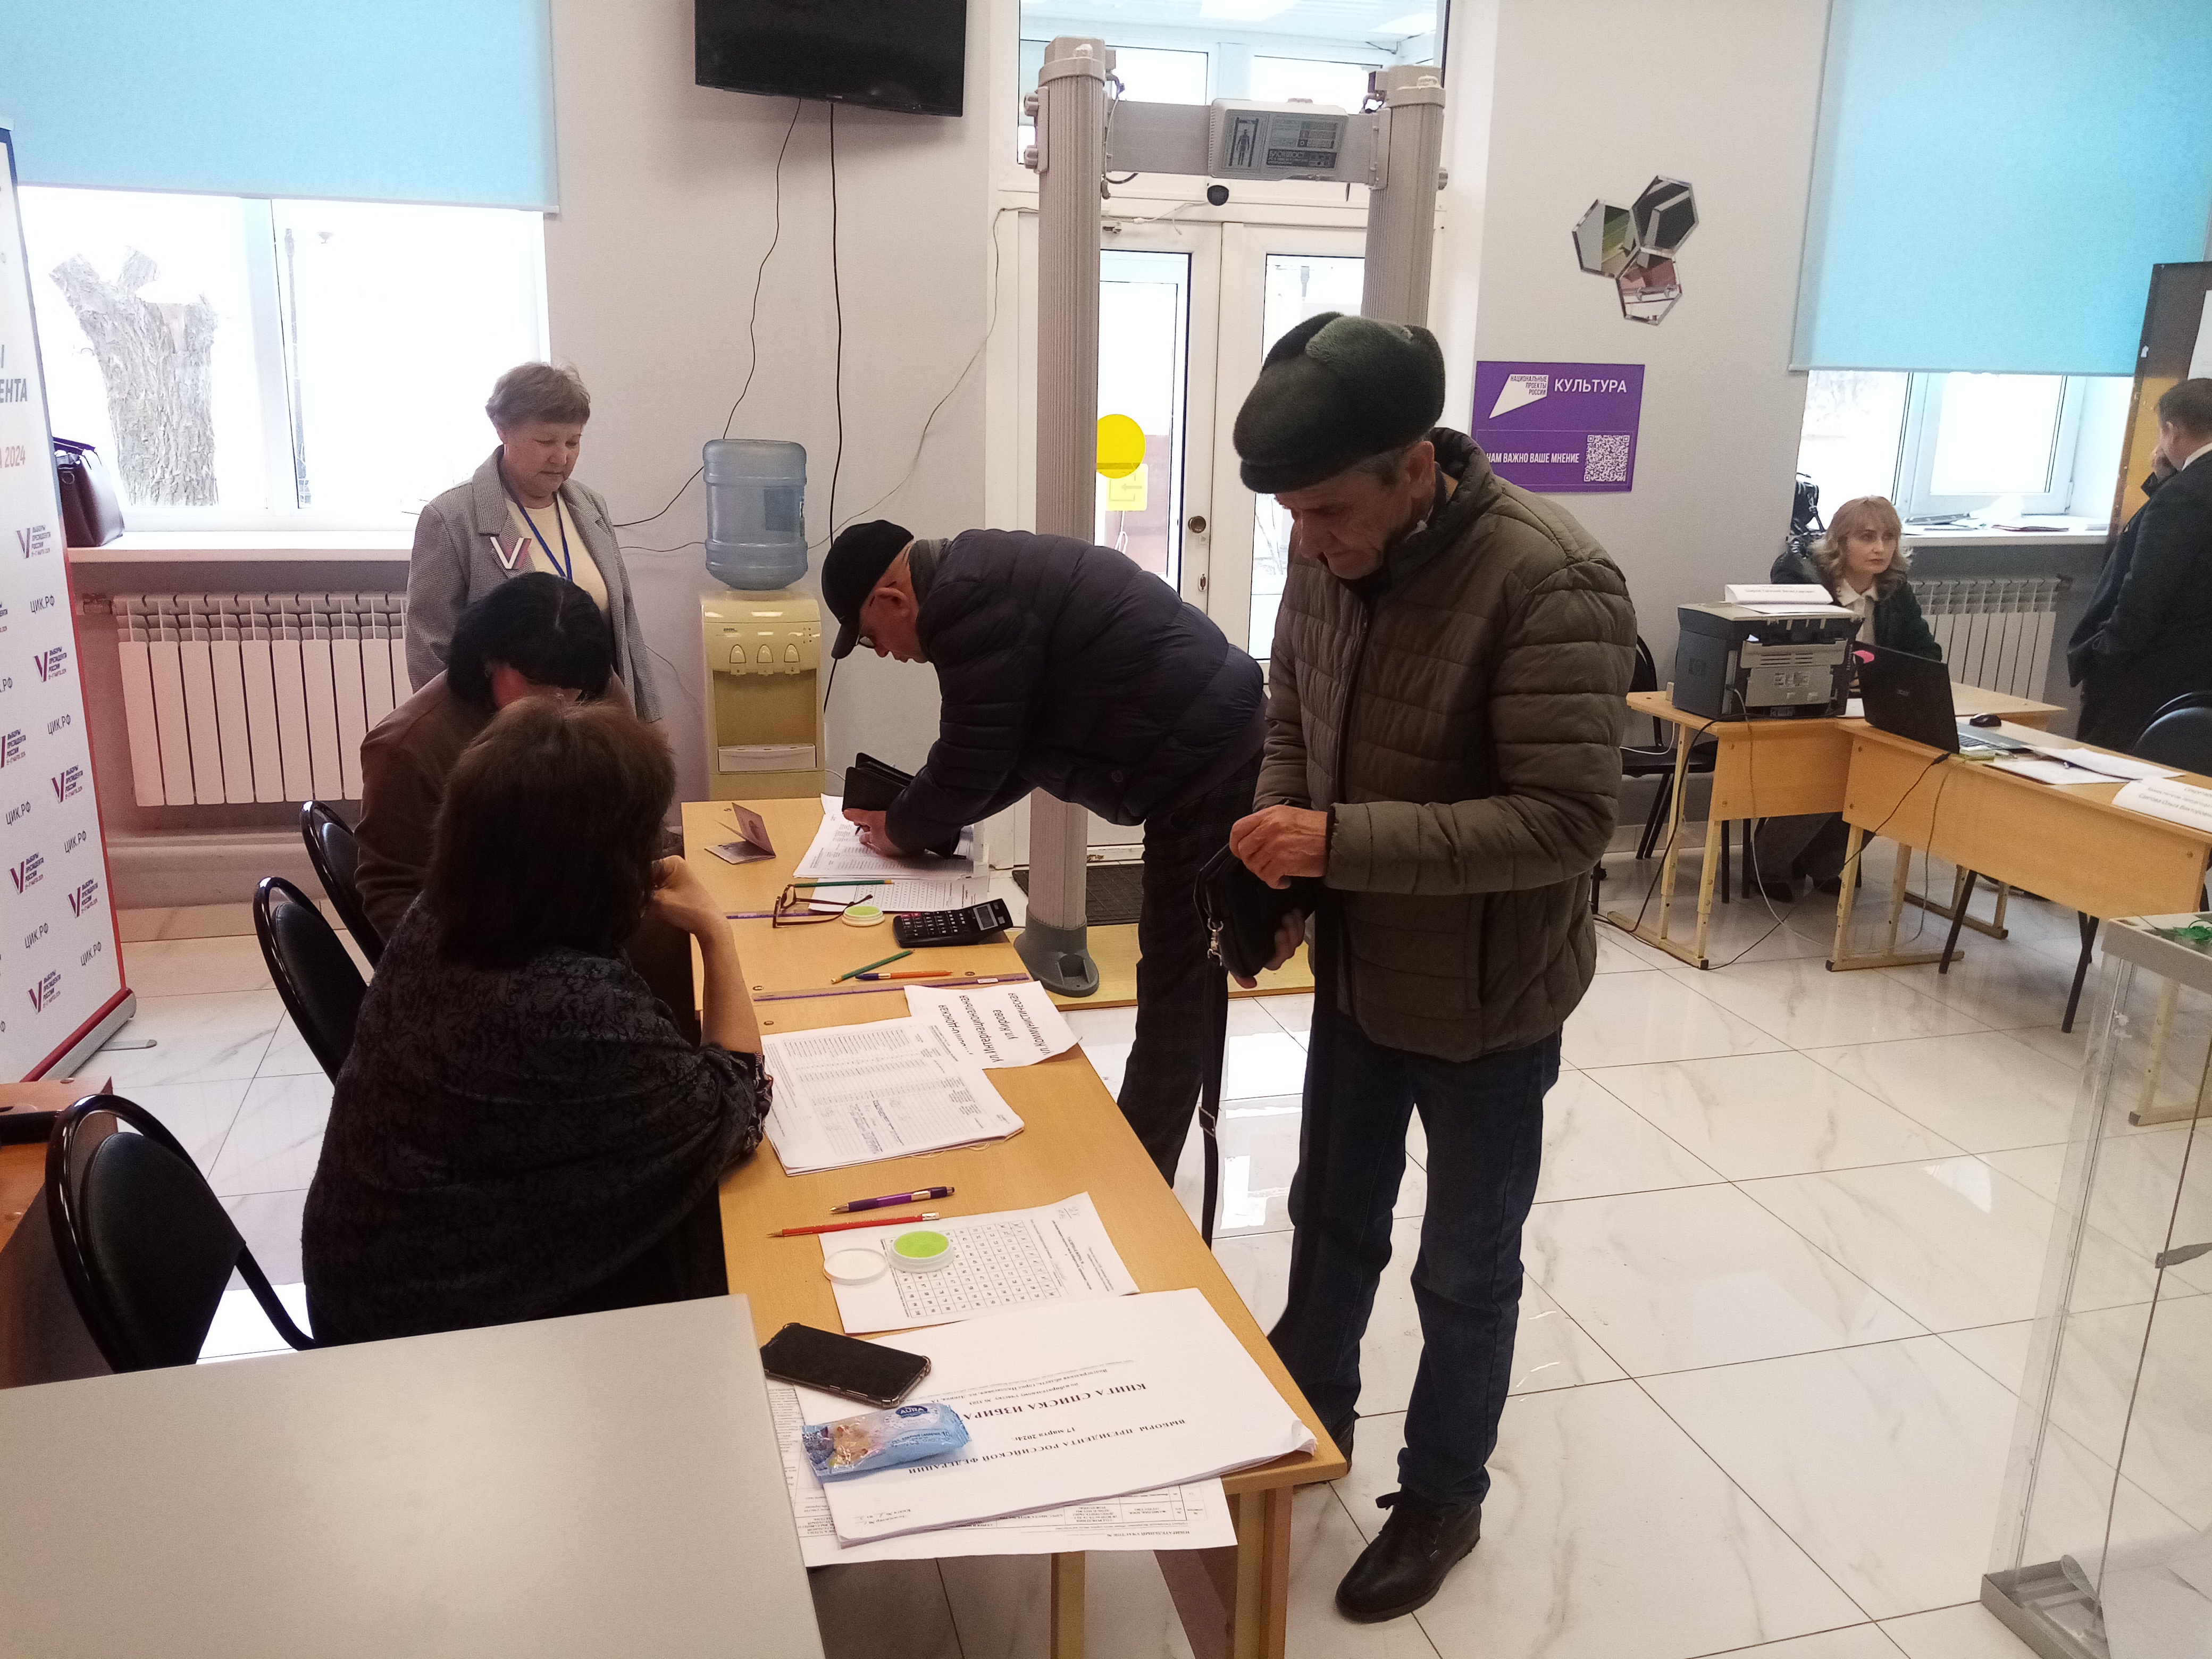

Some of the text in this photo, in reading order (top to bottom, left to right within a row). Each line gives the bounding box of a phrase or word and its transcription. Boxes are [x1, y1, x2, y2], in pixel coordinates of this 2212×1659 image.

[1554, 379, 1627, 393] КУЛЬТУРА
[5, 446, 26, 468] 2024
[1503, 453, 1529, 463] ВАЖНО
[1530, 453, 1549, 463] ВАШЕ
[1551, 453, 1580, 463] МНЕНИЕ
[30, 595, 55, 614] ЦИК.РФ
[0, 677, 13, 692] .РФ
[47, 714, 71, 735] ЦИК.РФ
[5, 801, 31, 826] ЦИК.РФ
[64, 830, 87, 853] ЦИК.РФ
[24, 923, 48, 949] ЦИК.РФ
[80, 941, 102, 967] ЦИК.РФ
[959, 994, 1004, 1063] ул.Интернациональная
[993, 1010, 1018, 1041] ул.Кирова
[1008, 992, 1052, 1055] ул.Коммунистическая
[1095, 1383, 1146, 1396] КНИГА
[1028, 1392, 1091, 1410] СПИСКА
[963, 1405, 1023, 1421] ИЗБИРА
[1038, 1429, 1064, 1438] марта
[908, 1419, 1186, 1474] ВЫБОРЫ ПРЕЗИДЕНТА РОССИЙСКОЙ ФЕДЕРАЦИИ
